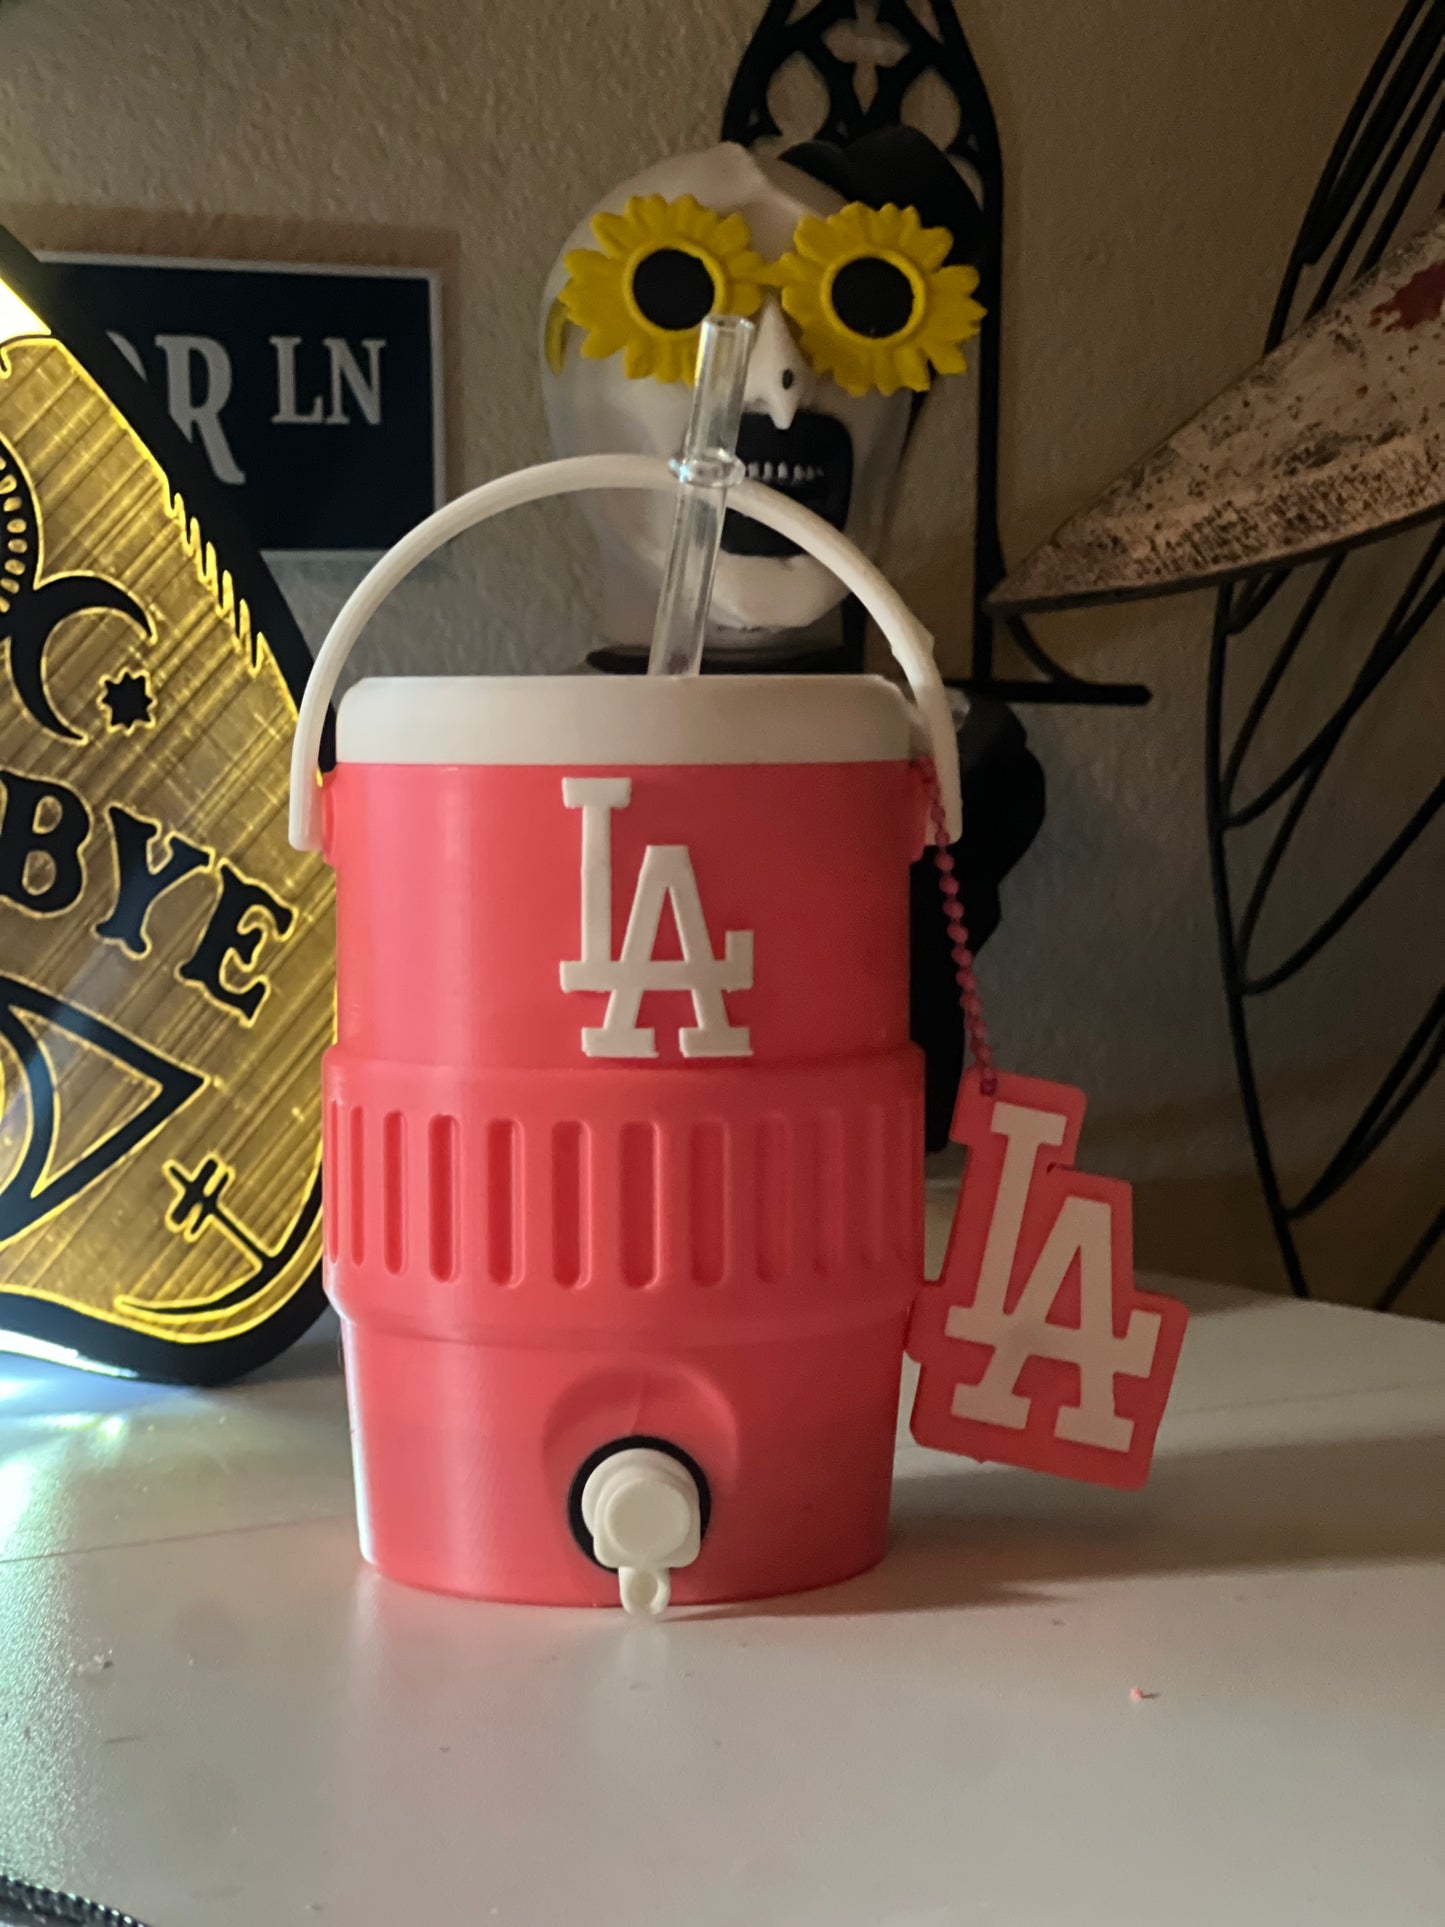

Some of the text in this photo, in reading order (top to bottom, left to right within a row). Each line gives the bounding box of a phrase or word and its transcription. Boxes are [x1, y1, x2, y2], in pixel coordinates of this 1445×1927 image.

[106, 329, 387, 485] R LN
[0, 769, 298, 1027] BYE
[560, 776, 753, 1058] LA
[945, 1101, 1162, 1453] LA
